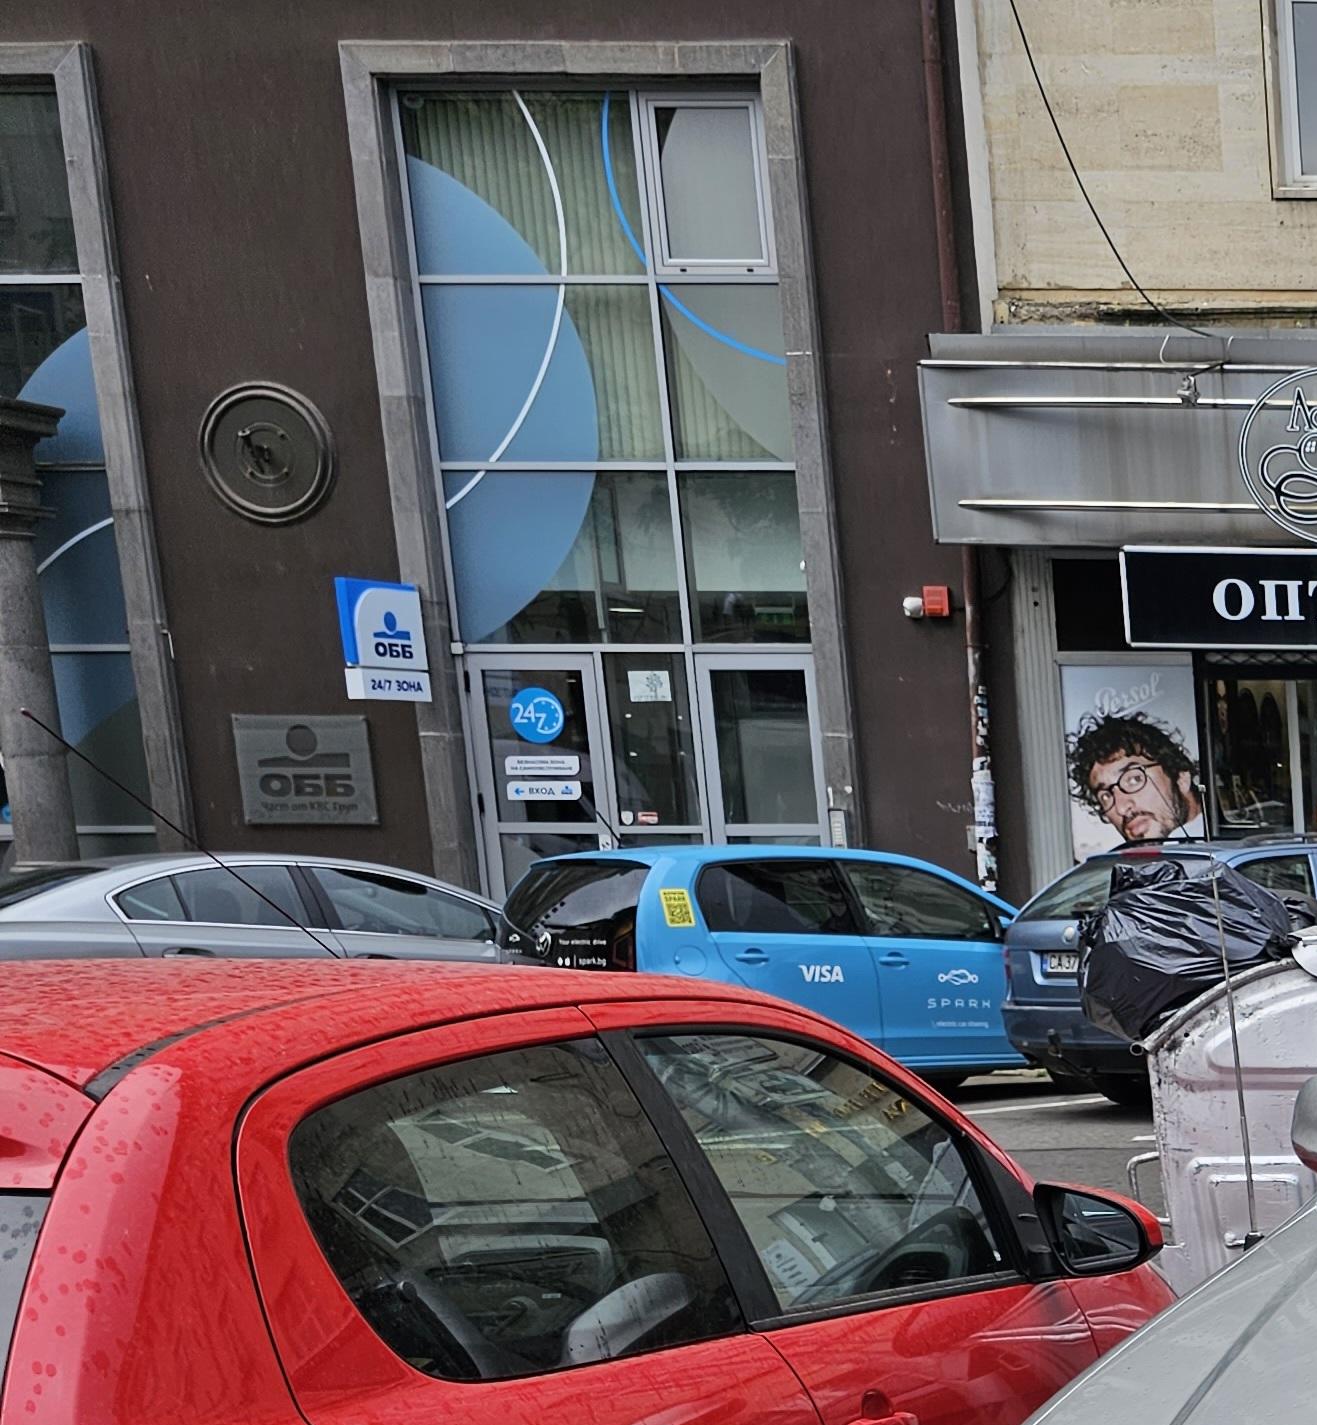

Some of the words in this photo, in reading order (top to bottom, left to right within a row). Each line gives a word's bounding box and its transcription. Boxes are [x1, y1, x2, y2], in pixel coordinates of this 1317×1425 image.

[374, 642, 414, 659] ОББ
[371, 679, 392, 692] 24/7
[396, 680, 424, 693] ЗОНА
[259, 773, 356, 798] ОББ
[528, 787, 555, 795] ВХОД
[798, 965, 844, 983] VISA
[928, 998, 991, 1009] SPARK
